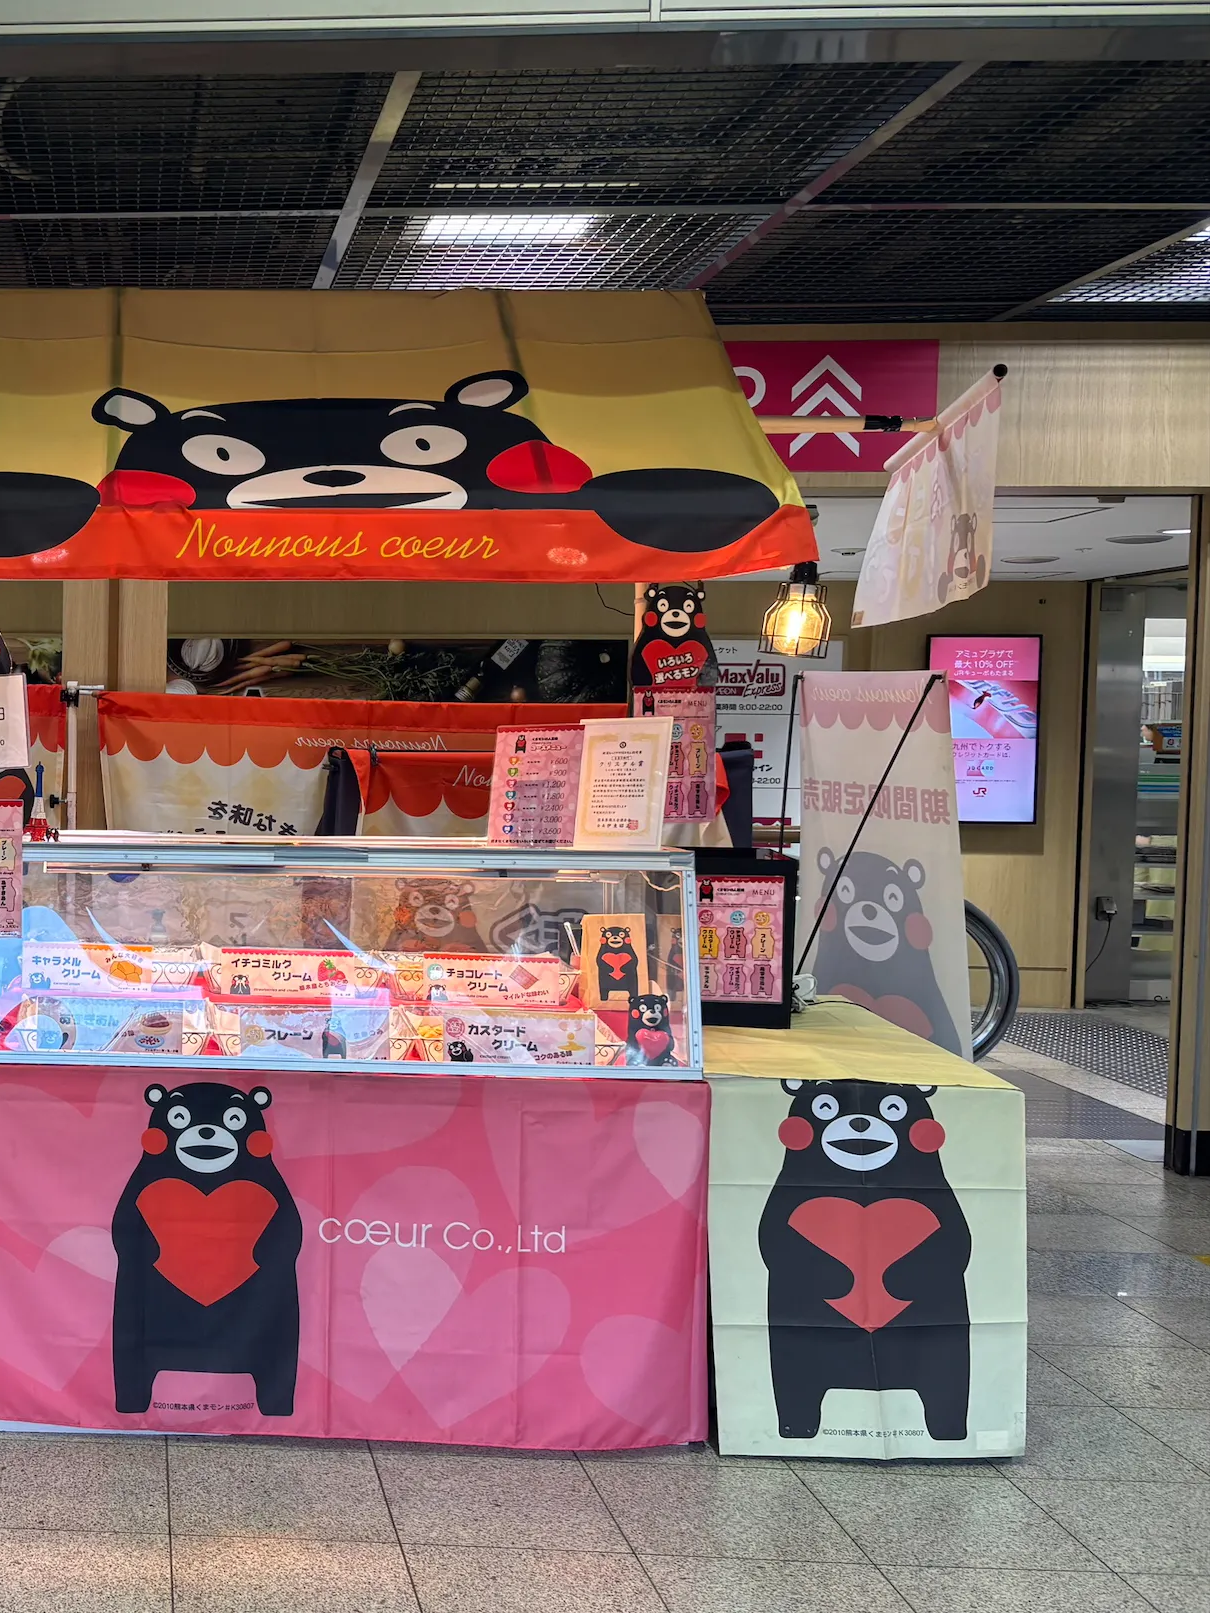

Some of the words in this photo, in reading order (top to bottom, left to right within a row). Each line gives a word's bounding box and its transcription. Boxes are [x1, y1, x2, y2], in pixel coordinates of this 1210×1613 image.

[379, 534, 500, 559] coeur
[657, 652, 693, 668] いろいろ
[955, 650, 1013, 659] アミュプラザで
[654, 667, 699, 684] 選べるモン
[743, 682, 784, 698] Express
[738, 703, 783, 711] 9:00-22:00
[972, 787, 988, 796] JR
[31, 956, 82, 967] キャラメル
[231, 958, 292, 969] イチゴミルク
[61, 968, 101, 980] クリーム
[271, 971, 312, 982] クリーム
[446, 968, 503, 980] チョコレート
[467, 981, 509, 992] クリーム
[467, 1024, 526, 1037] カスタード
[491, 1039, 539, 1052] クリーム
